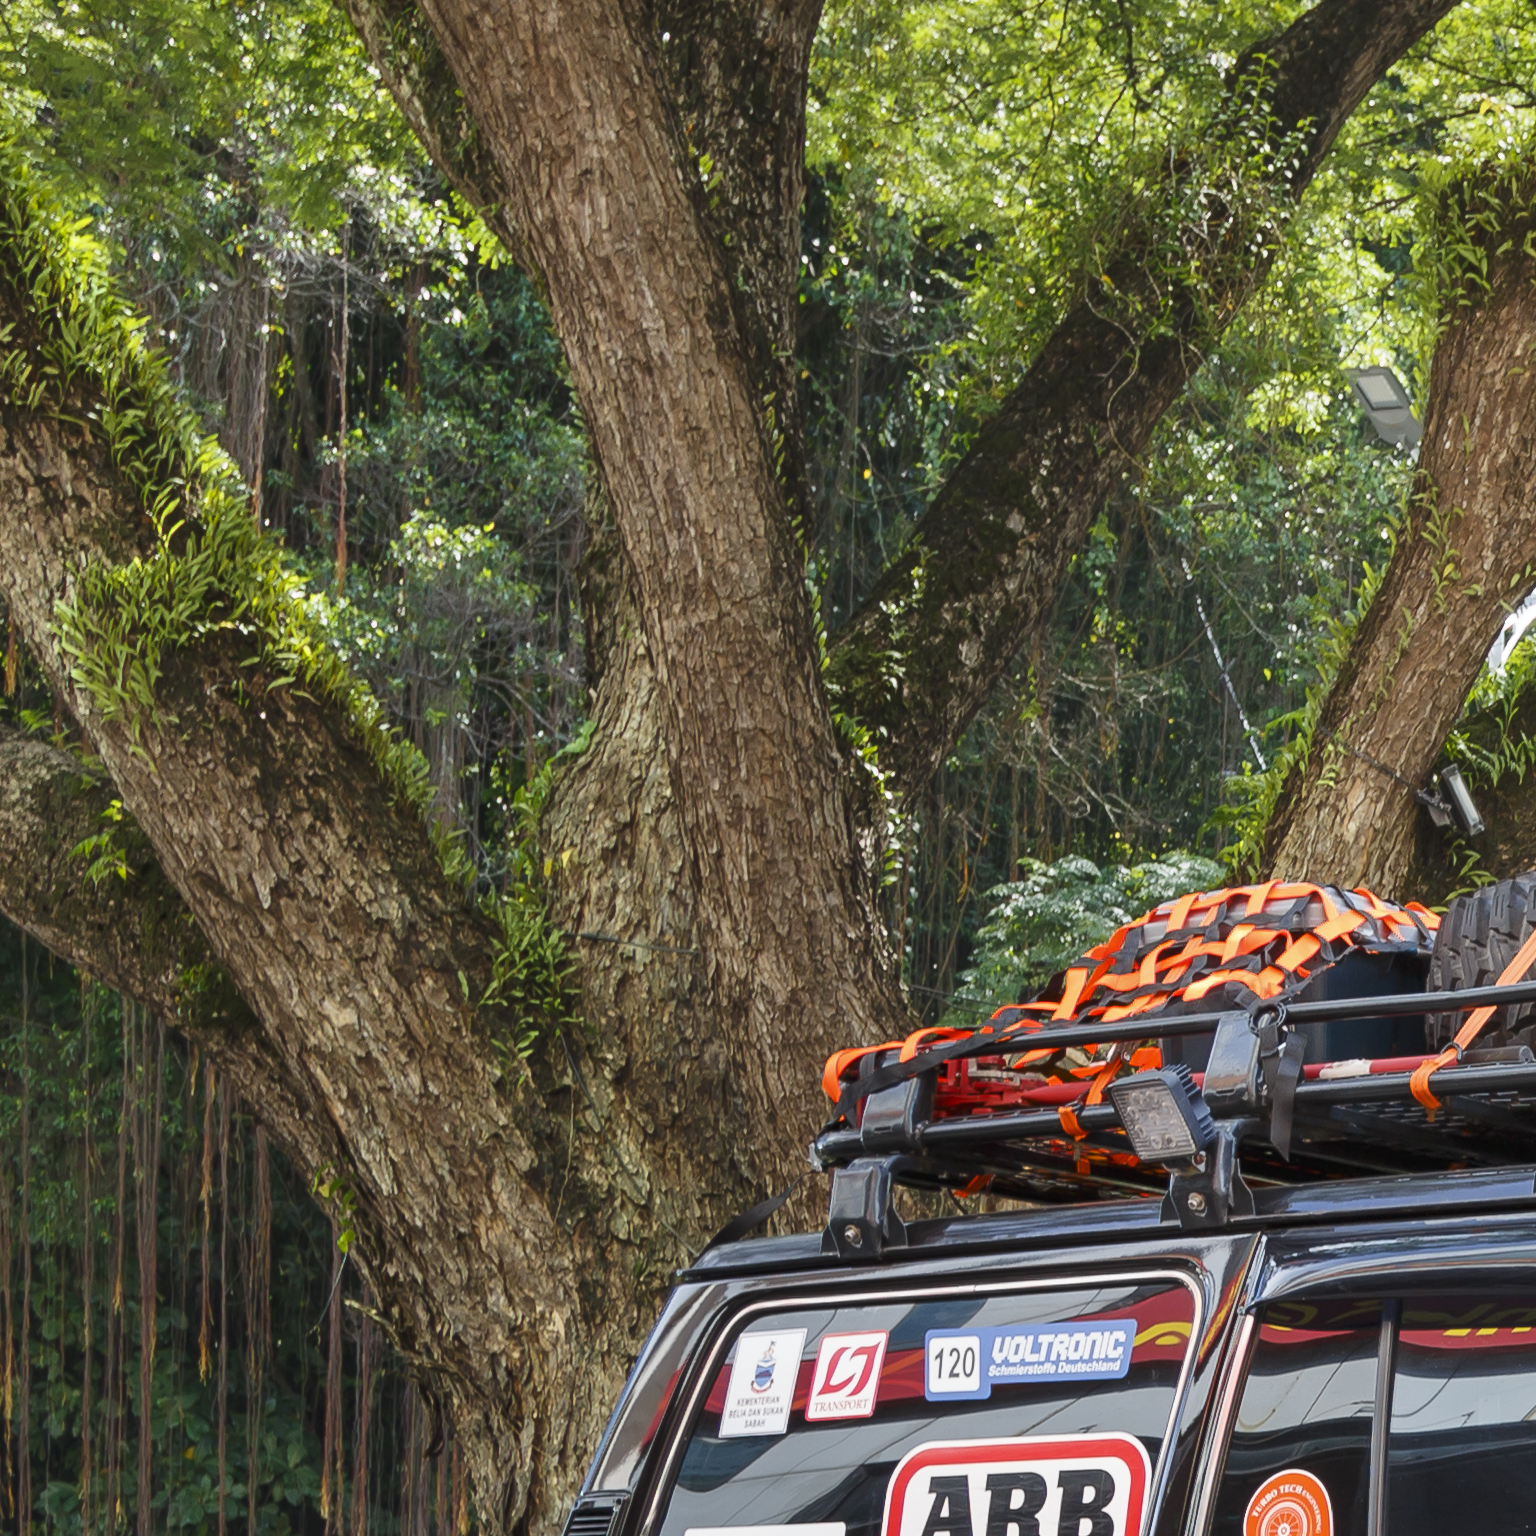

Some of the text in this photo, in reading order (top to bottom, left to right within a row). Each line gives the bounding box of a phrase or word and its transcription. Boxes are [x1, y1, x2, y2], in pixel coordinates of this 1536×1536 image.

[992, 1331, 1126, 1364] VOLTRONIC
[934, 1347, 975, 1379] 120
[988, 1359, 1121, 1377] Schmierstoffe Deutschland
[737, 1396, 780, 1406] KEMENTERIAN
[814, 1399, 869, 1412] TRANSPORT
[744, 1420, 765, 1428] SABAH
[1251, 1488, 1278, 1518] TURBO
[1279, 1484, 1303, 1494] TECH
